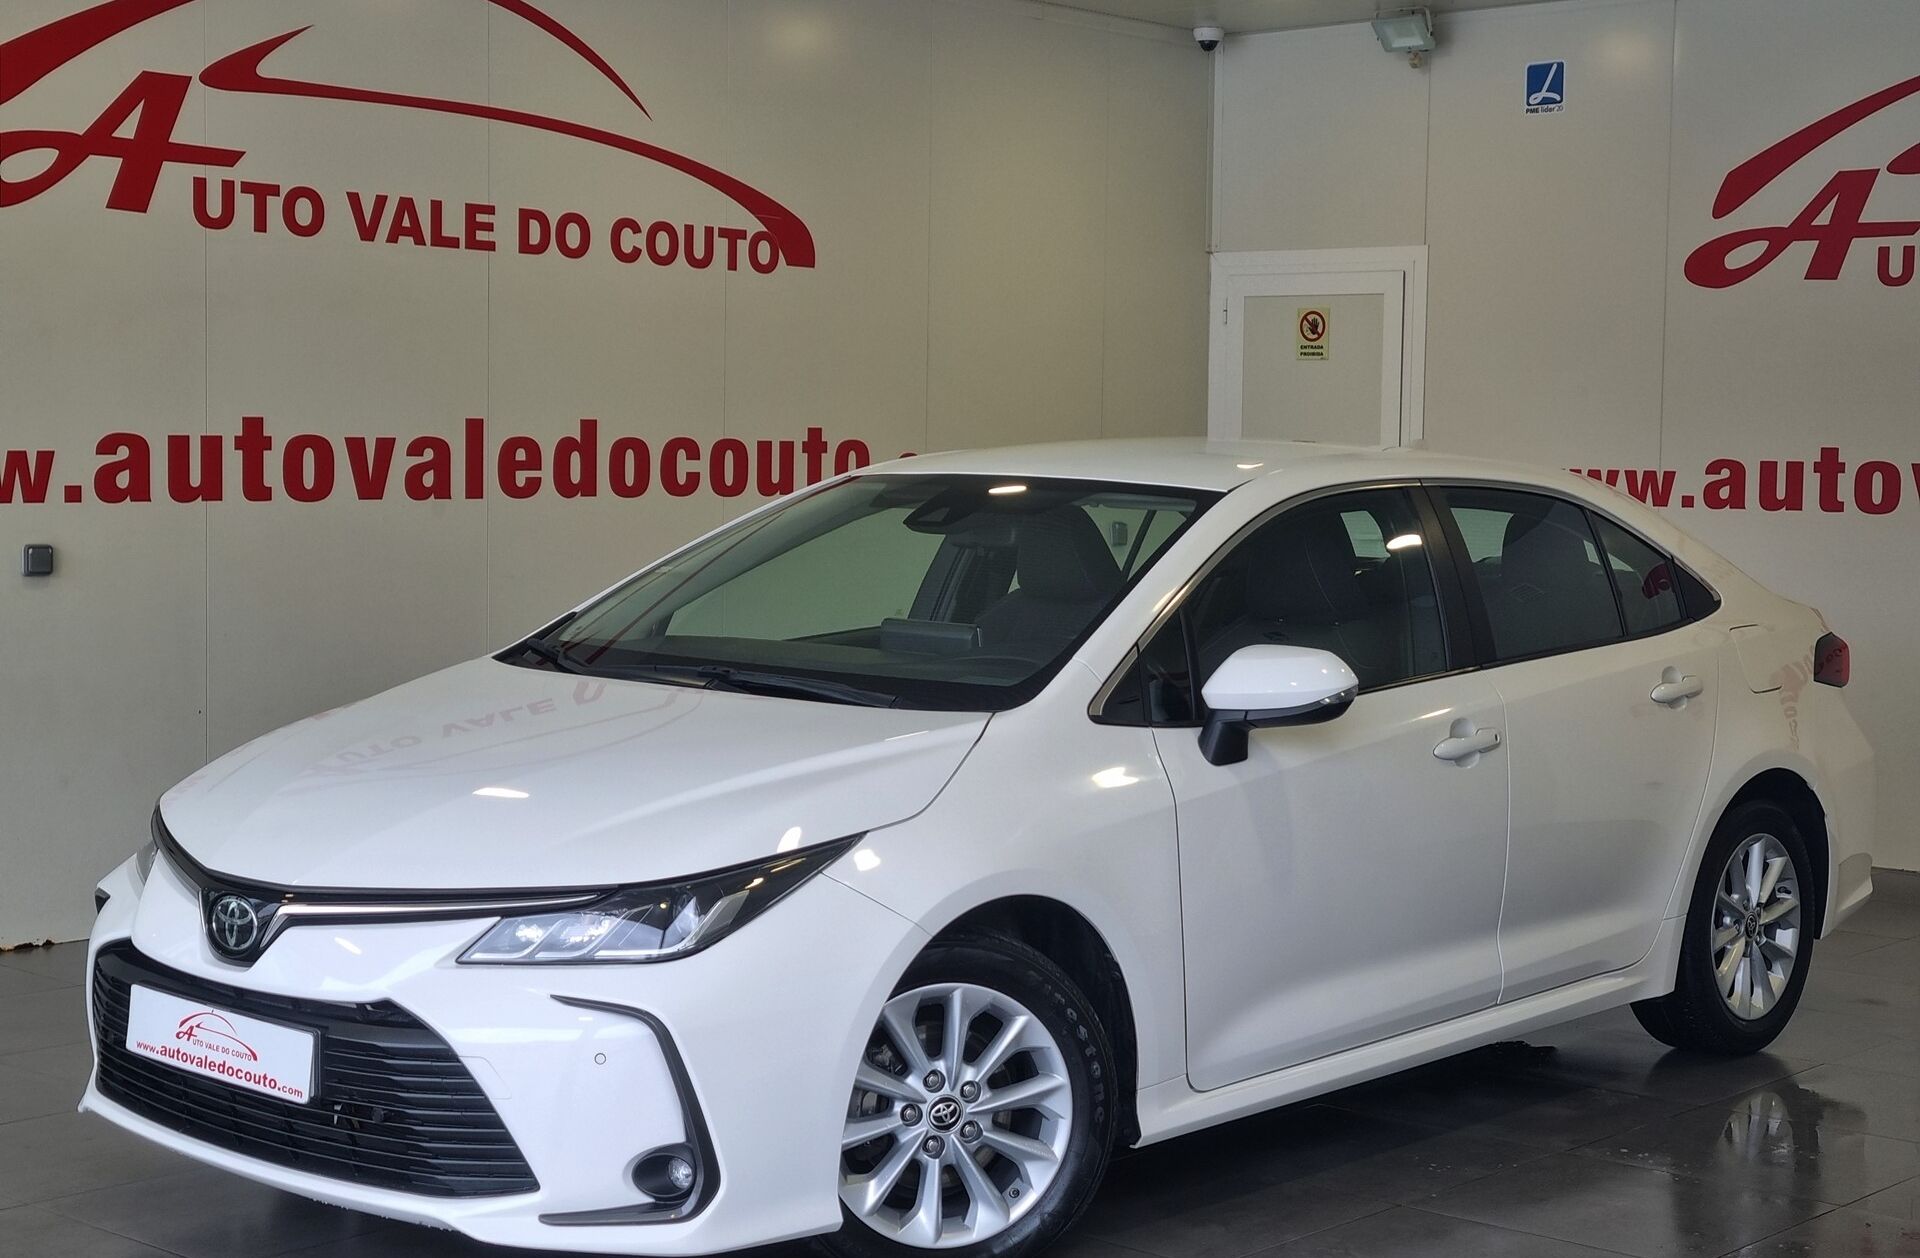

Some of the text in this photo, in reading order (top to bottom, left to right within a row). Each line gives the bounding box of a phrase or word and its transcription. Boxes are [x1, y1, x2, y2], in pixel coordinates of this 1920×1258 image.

[348, 192, 496, 251] VALE
[519, 208, 591, 259] DO
[611, 218, 779, 275] COUTO
[0, 416, 917, 504] w.autovaledocouto
[1569, 448, 1920, 514] w.auto
[136, 1040, 303, 1099] www.autovaledocouto.com
[204, 1042, 220, 1053] VALE
[221, 1047, 230, 1055] DO
[231, 1049, 252, 1062] COUTO
